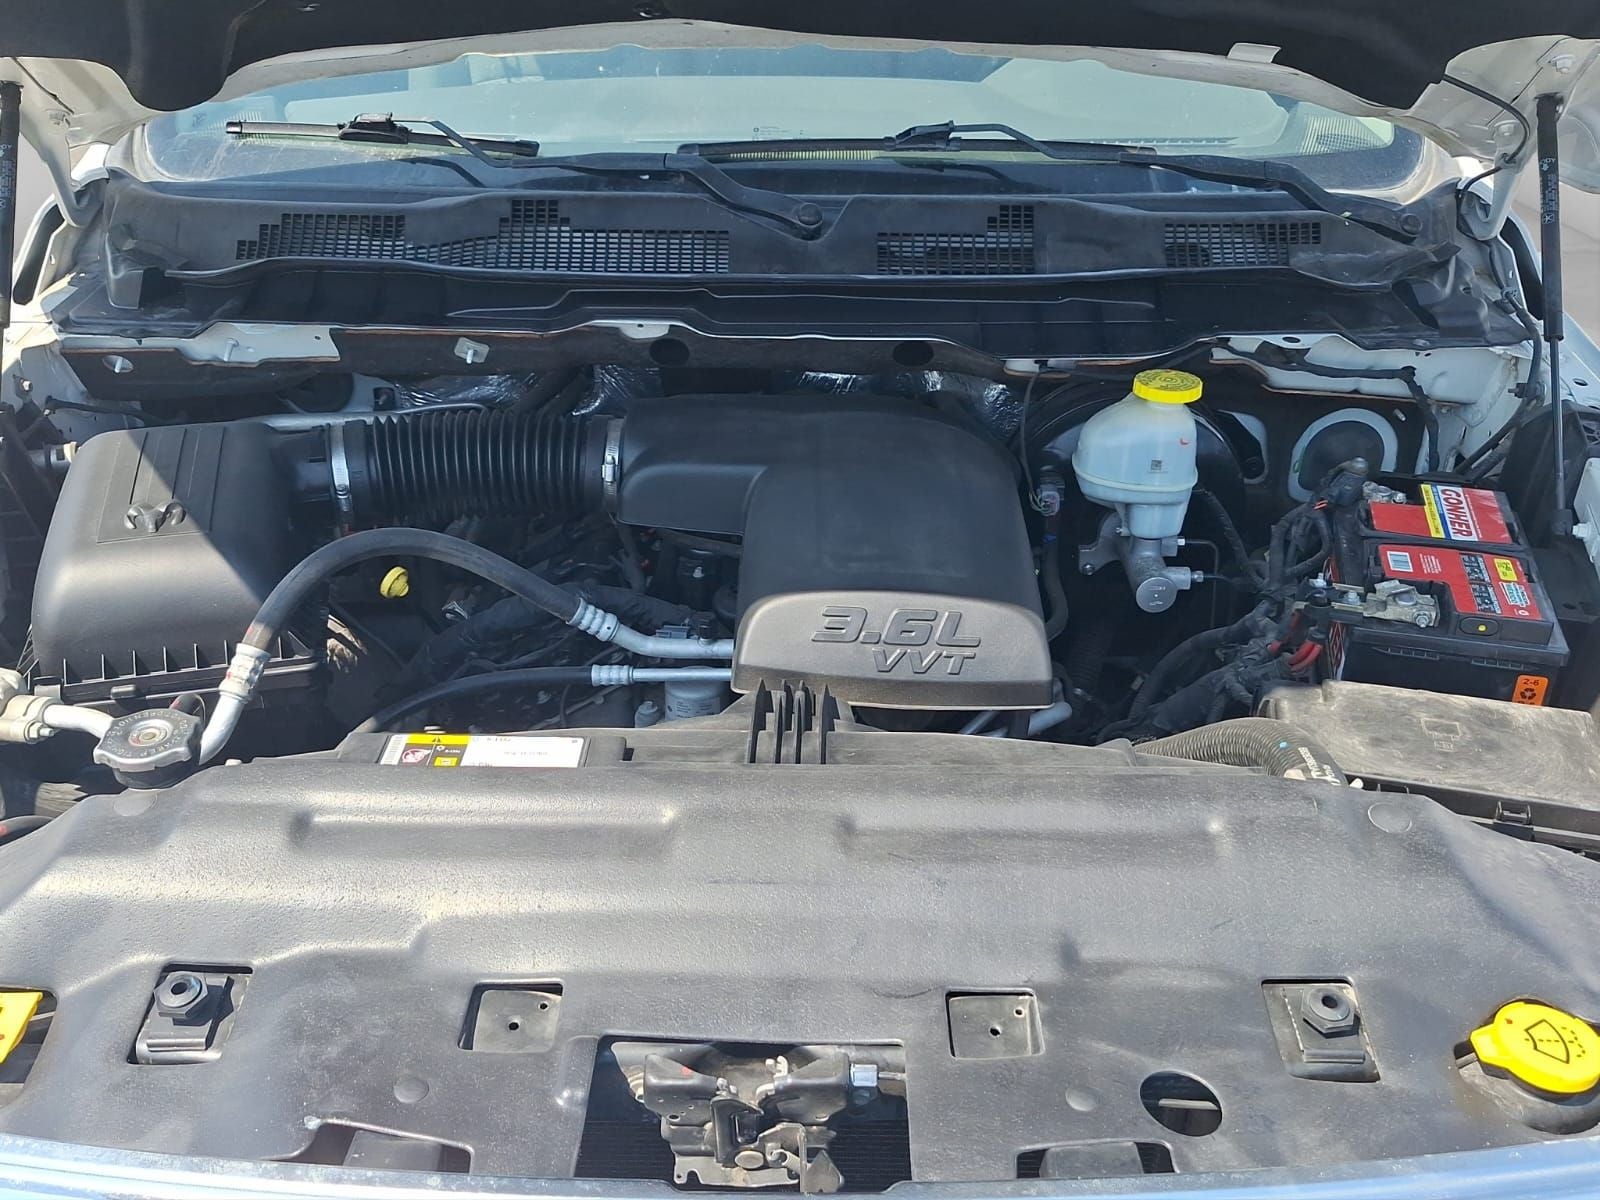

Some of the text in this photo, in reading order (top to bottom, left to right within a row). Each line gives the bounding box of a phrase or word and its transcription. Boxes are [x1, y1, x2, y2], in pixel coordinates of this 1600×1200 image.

[1440, 488, 1471, 538] GONHER
[811, 605, 982, 648] 3.6L
[871, 648, 976, 675] VVT
